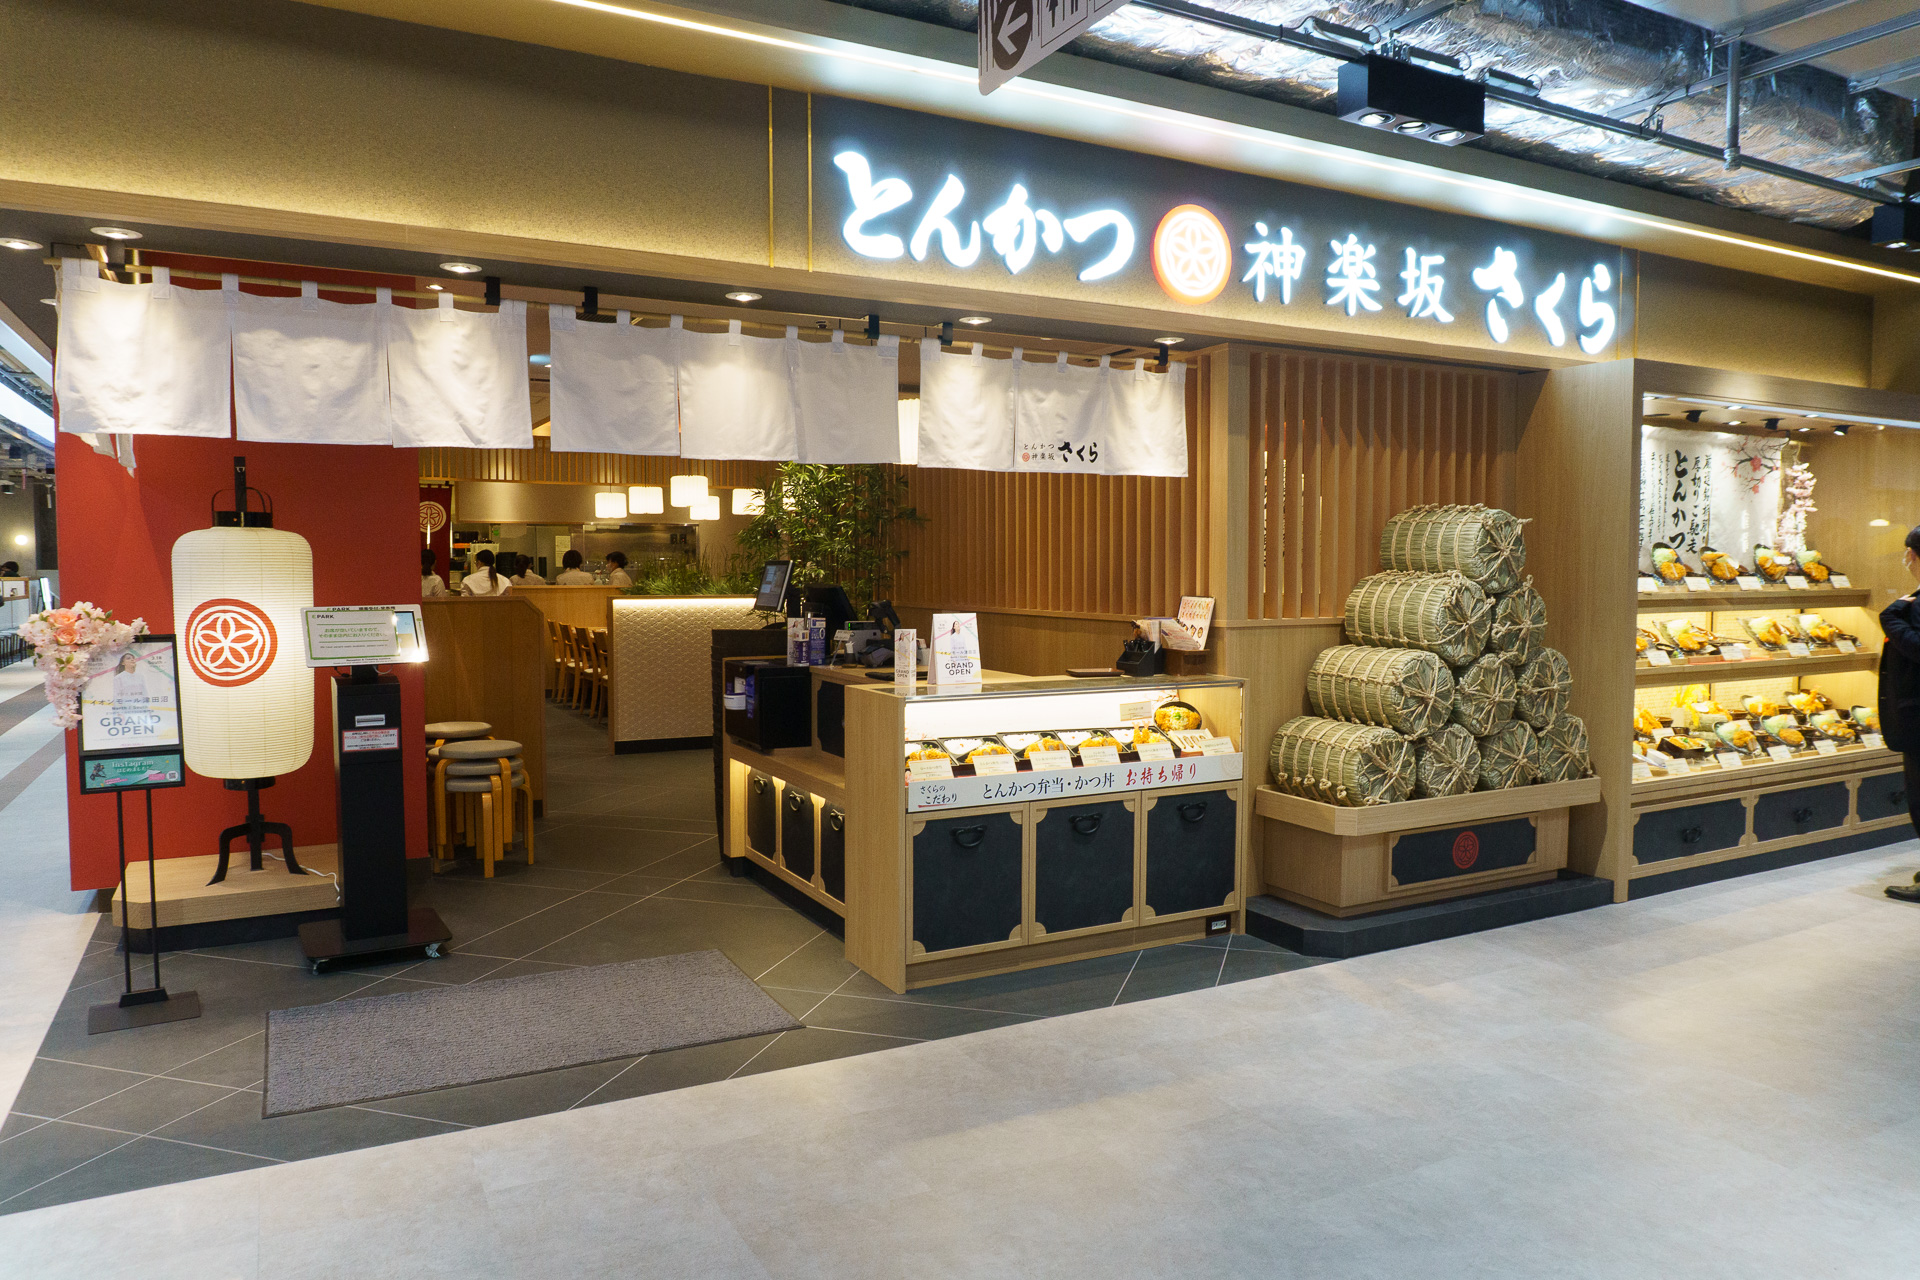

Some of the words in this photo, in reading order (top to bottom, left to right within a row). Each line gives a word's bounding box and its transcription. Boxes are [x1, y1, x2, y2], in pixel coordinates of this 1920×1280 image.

[833, 151, 1135, 281] とんかつ
[1242, 222, 1454, 323] 神楽坂
[1472, 246, 1616, 355] さくら
[1031, 452, 1055, 460] 神楽坂
[1058, 441, 1098, 463] さくら
[1669, 449, 1688, 550] とんかつ
[945, 661, 974, 670] GRAND
[91, 695, 169, 706] イオンモール津田沼
[100, 714, 161, 727] GRAND
[107, 725, 155, 737] OPEN
[112, 760, 153, 769] Instagram
[1125, 762, 1197, 787] お持ち帰り
[920, 784, 946, 795] さくらの
[925, 793, 957, 805] こだわり
